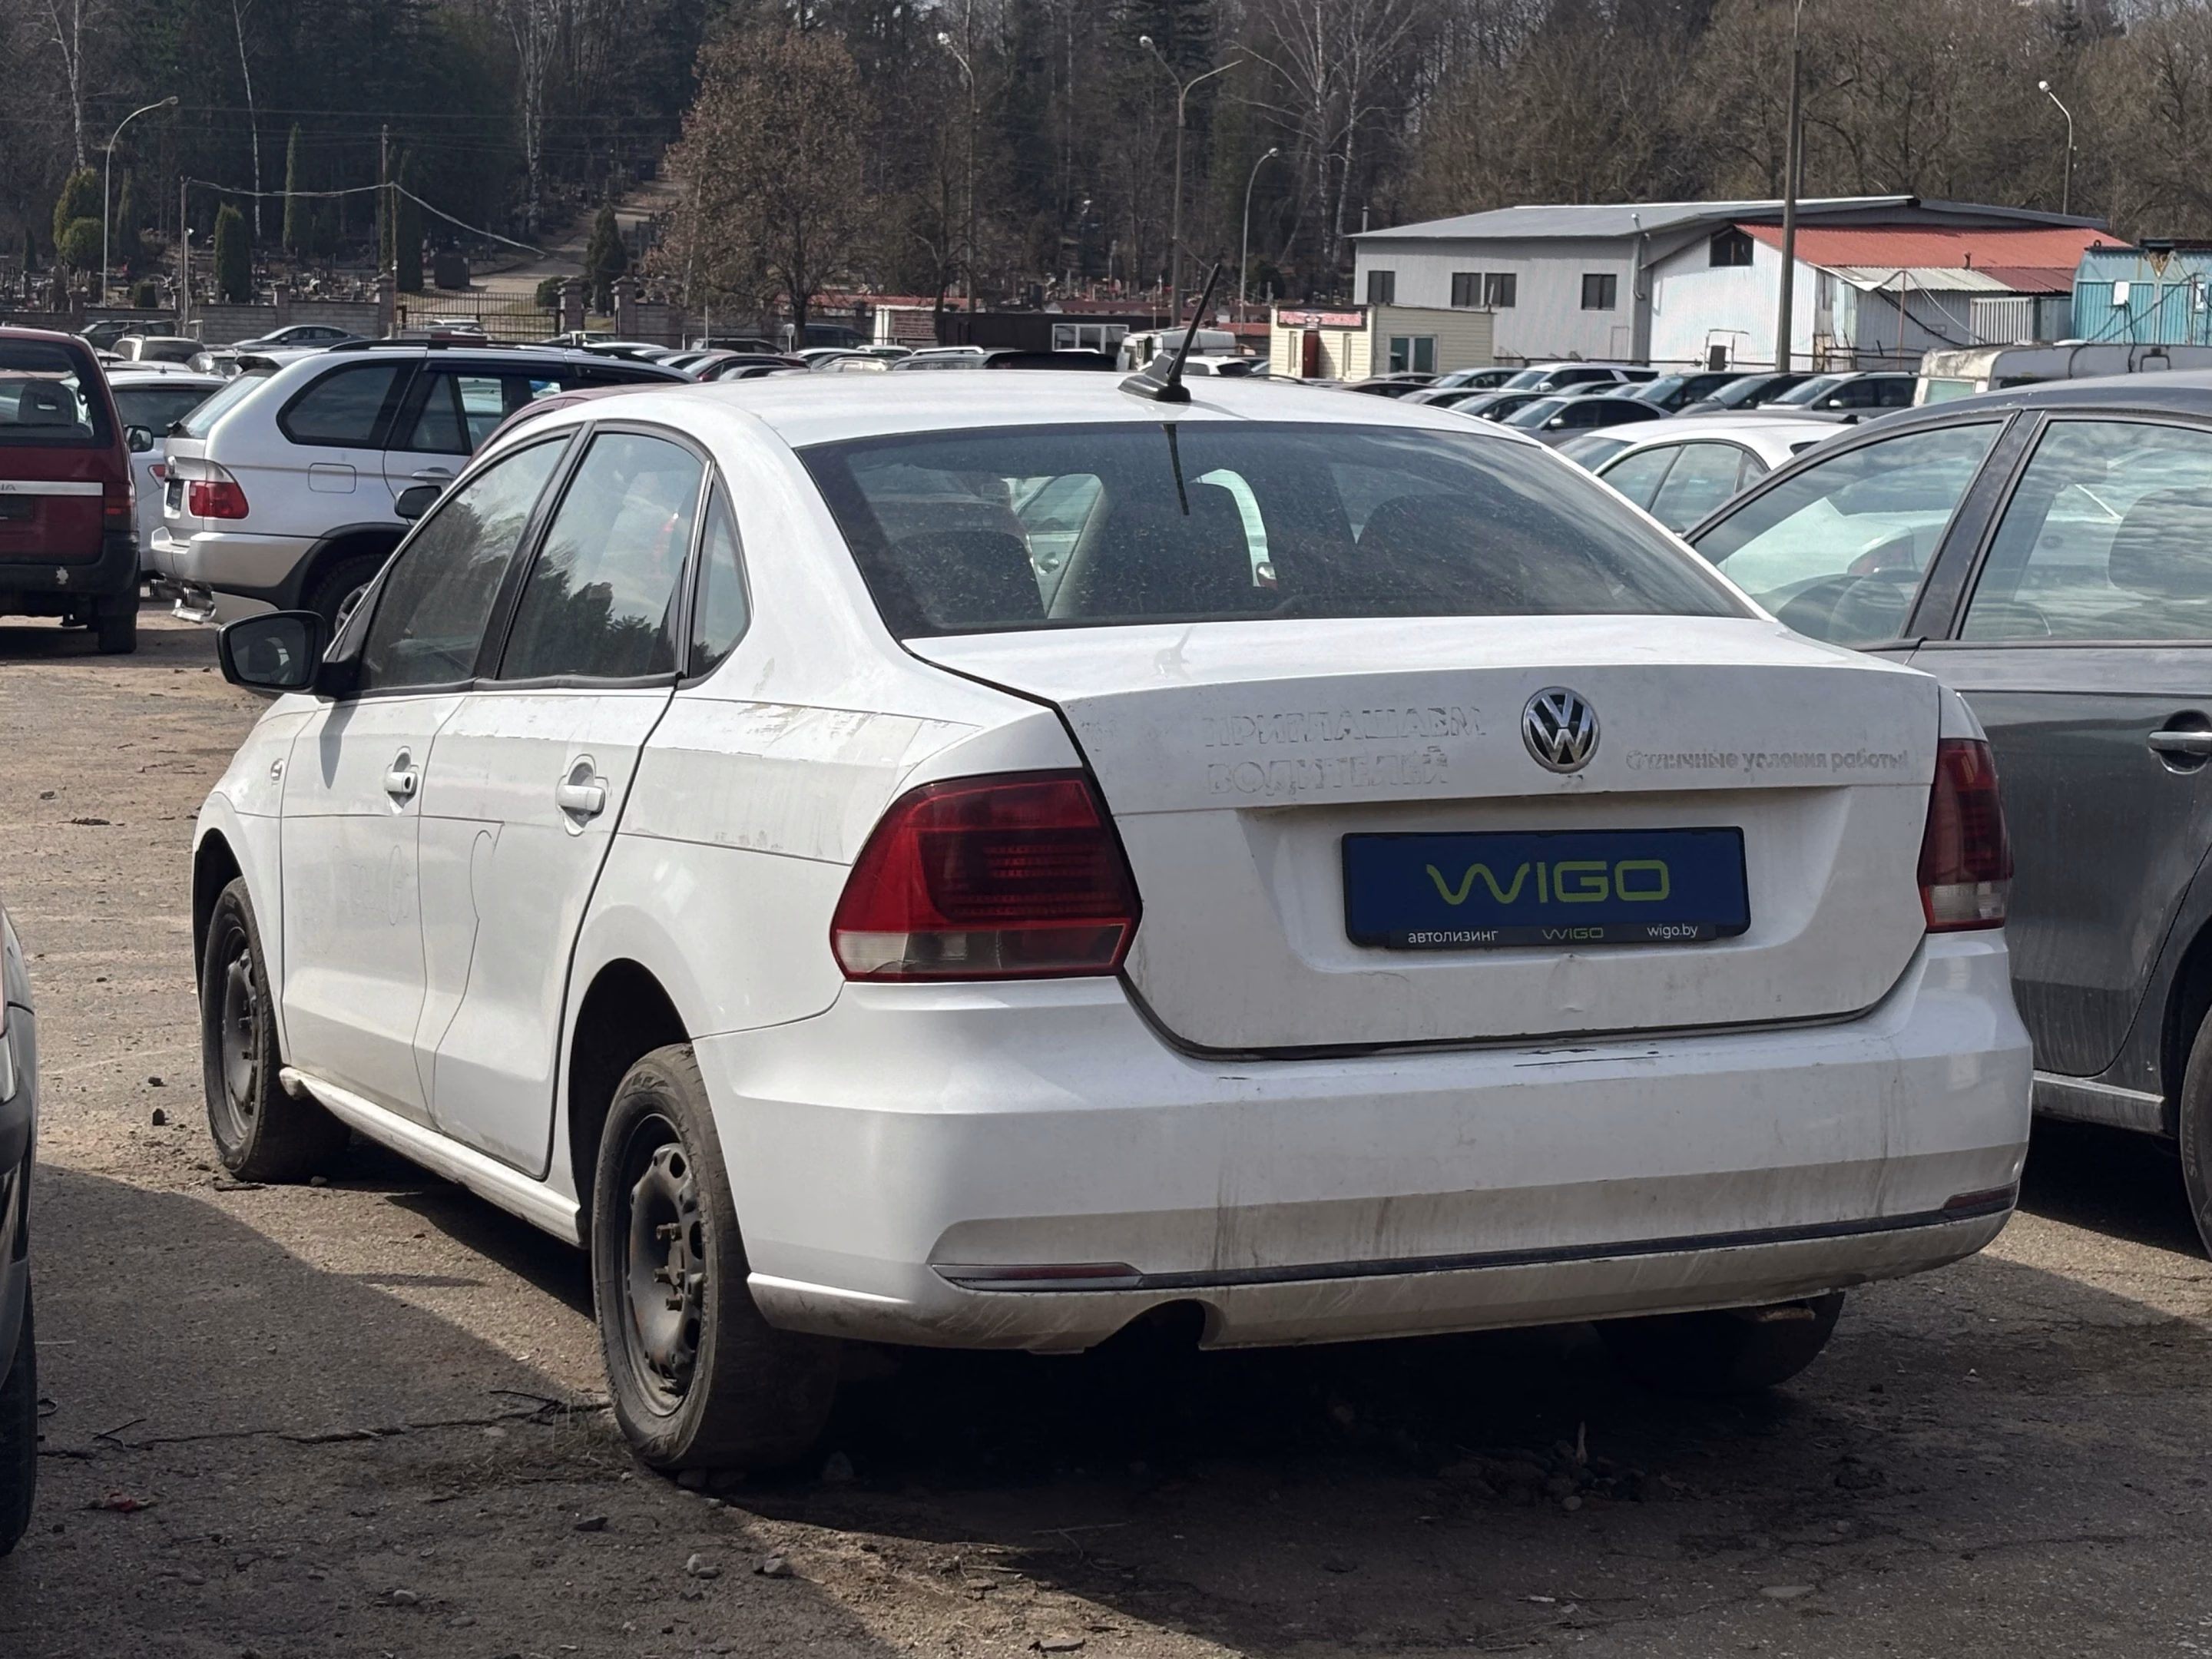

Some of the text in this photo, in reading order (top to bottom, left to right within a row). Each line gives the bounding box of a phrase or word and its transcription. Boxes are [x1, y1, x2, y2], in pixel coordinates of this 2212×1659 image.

[1426, 859, 1670, 906] WIGO
[1408, 929, 1498, 944] автолизинг
[1541, 927, 1604, 940] WIGO
[1647, 924, 1698, 939] wigo.by
